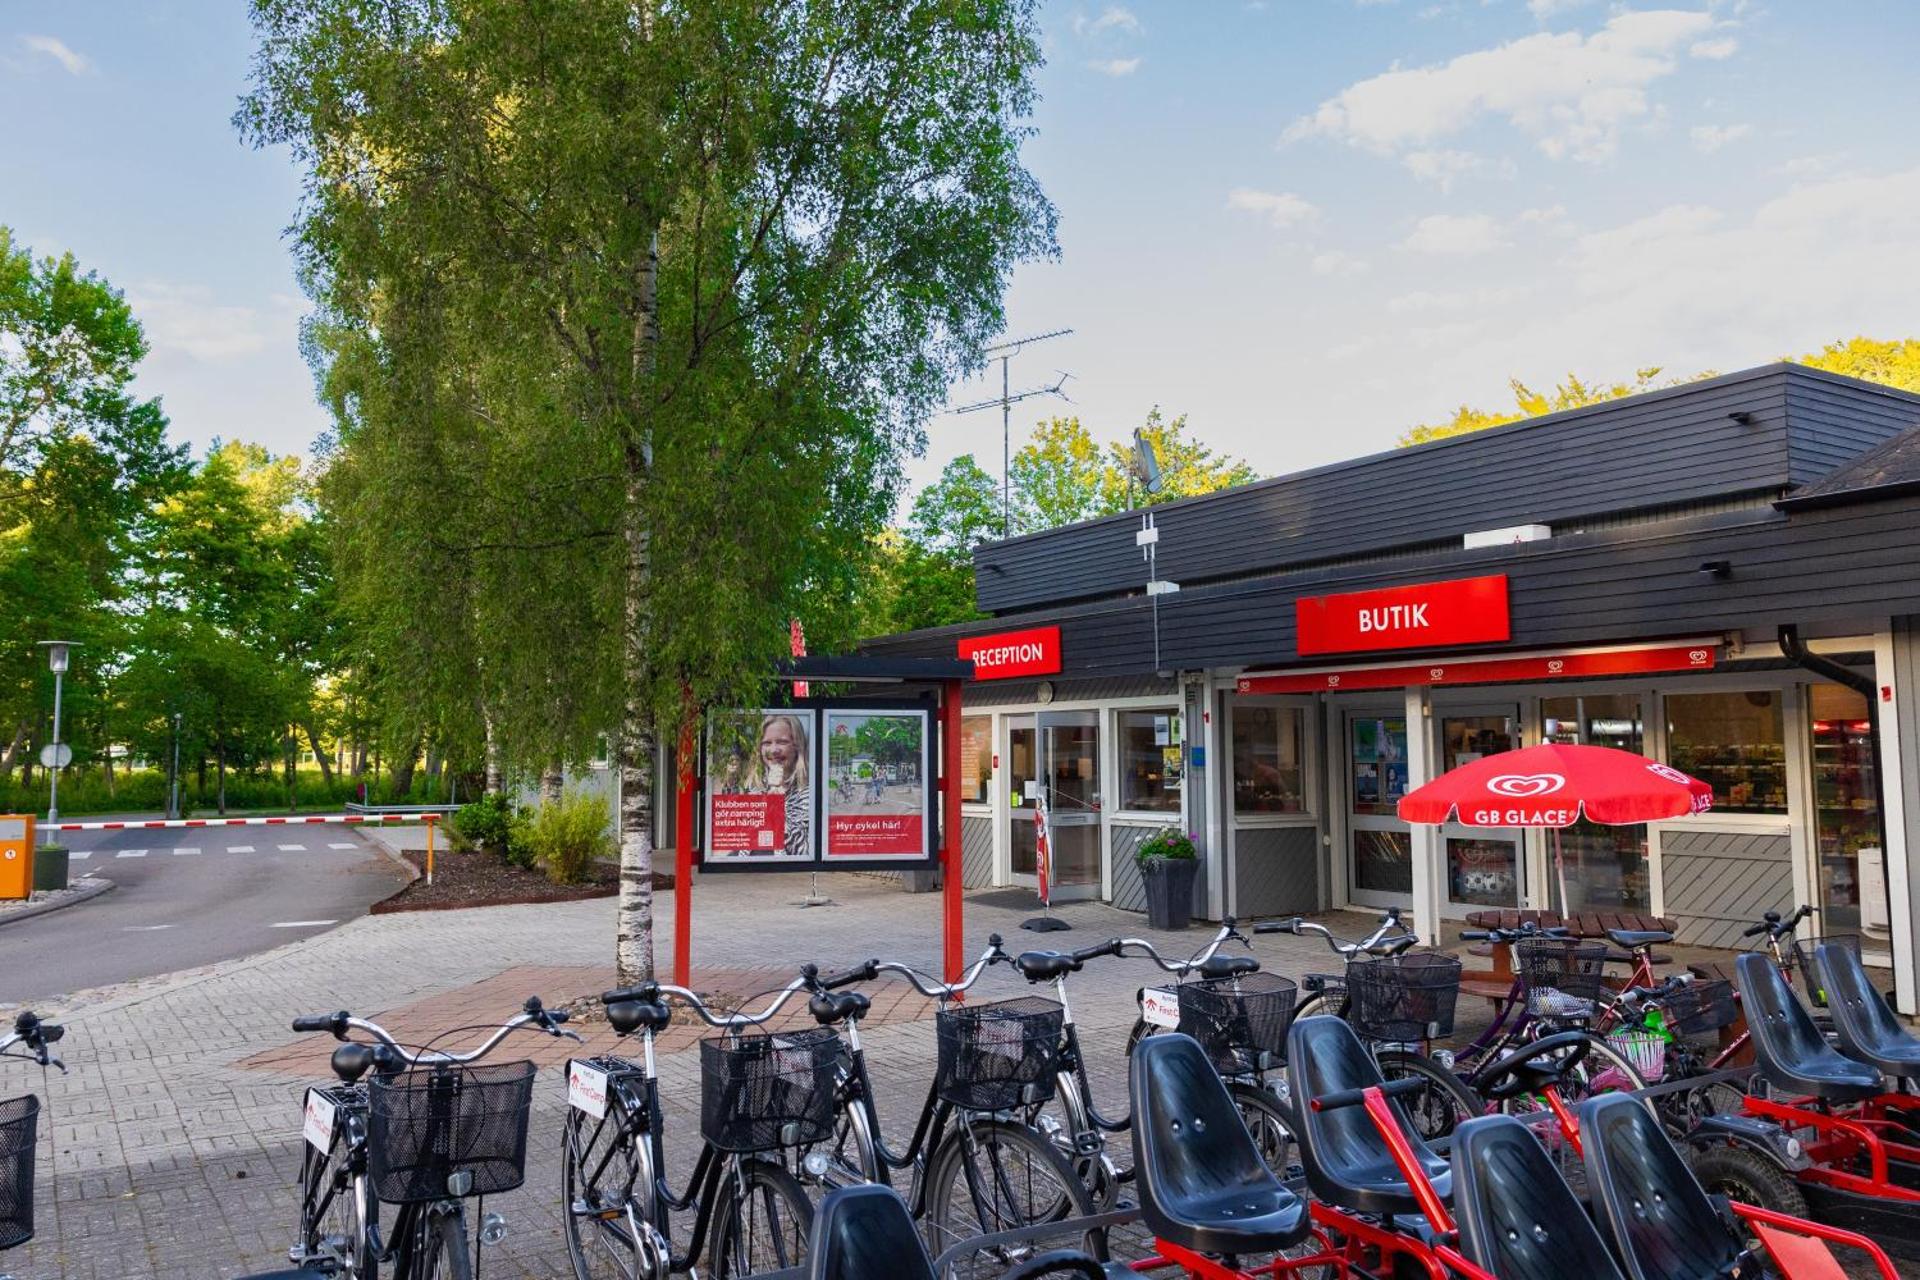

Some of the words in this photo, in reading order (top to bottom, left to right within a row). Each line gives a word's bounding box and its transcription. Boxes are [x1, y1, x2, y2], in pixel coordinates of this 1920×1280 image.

[1358, 602, 1430, 633] BUTIK
[972, 642, 1043, 668] RECEPTION
[730, 810, 765, 819] camping
[1475, 810, 1500, 824] GB
[1505, 810, 1567, 824] GLACE
[715, 819, 736, 827] extra
[836, 821, 853, 831] Hyr
[855, 821, 880, 831] cykel
